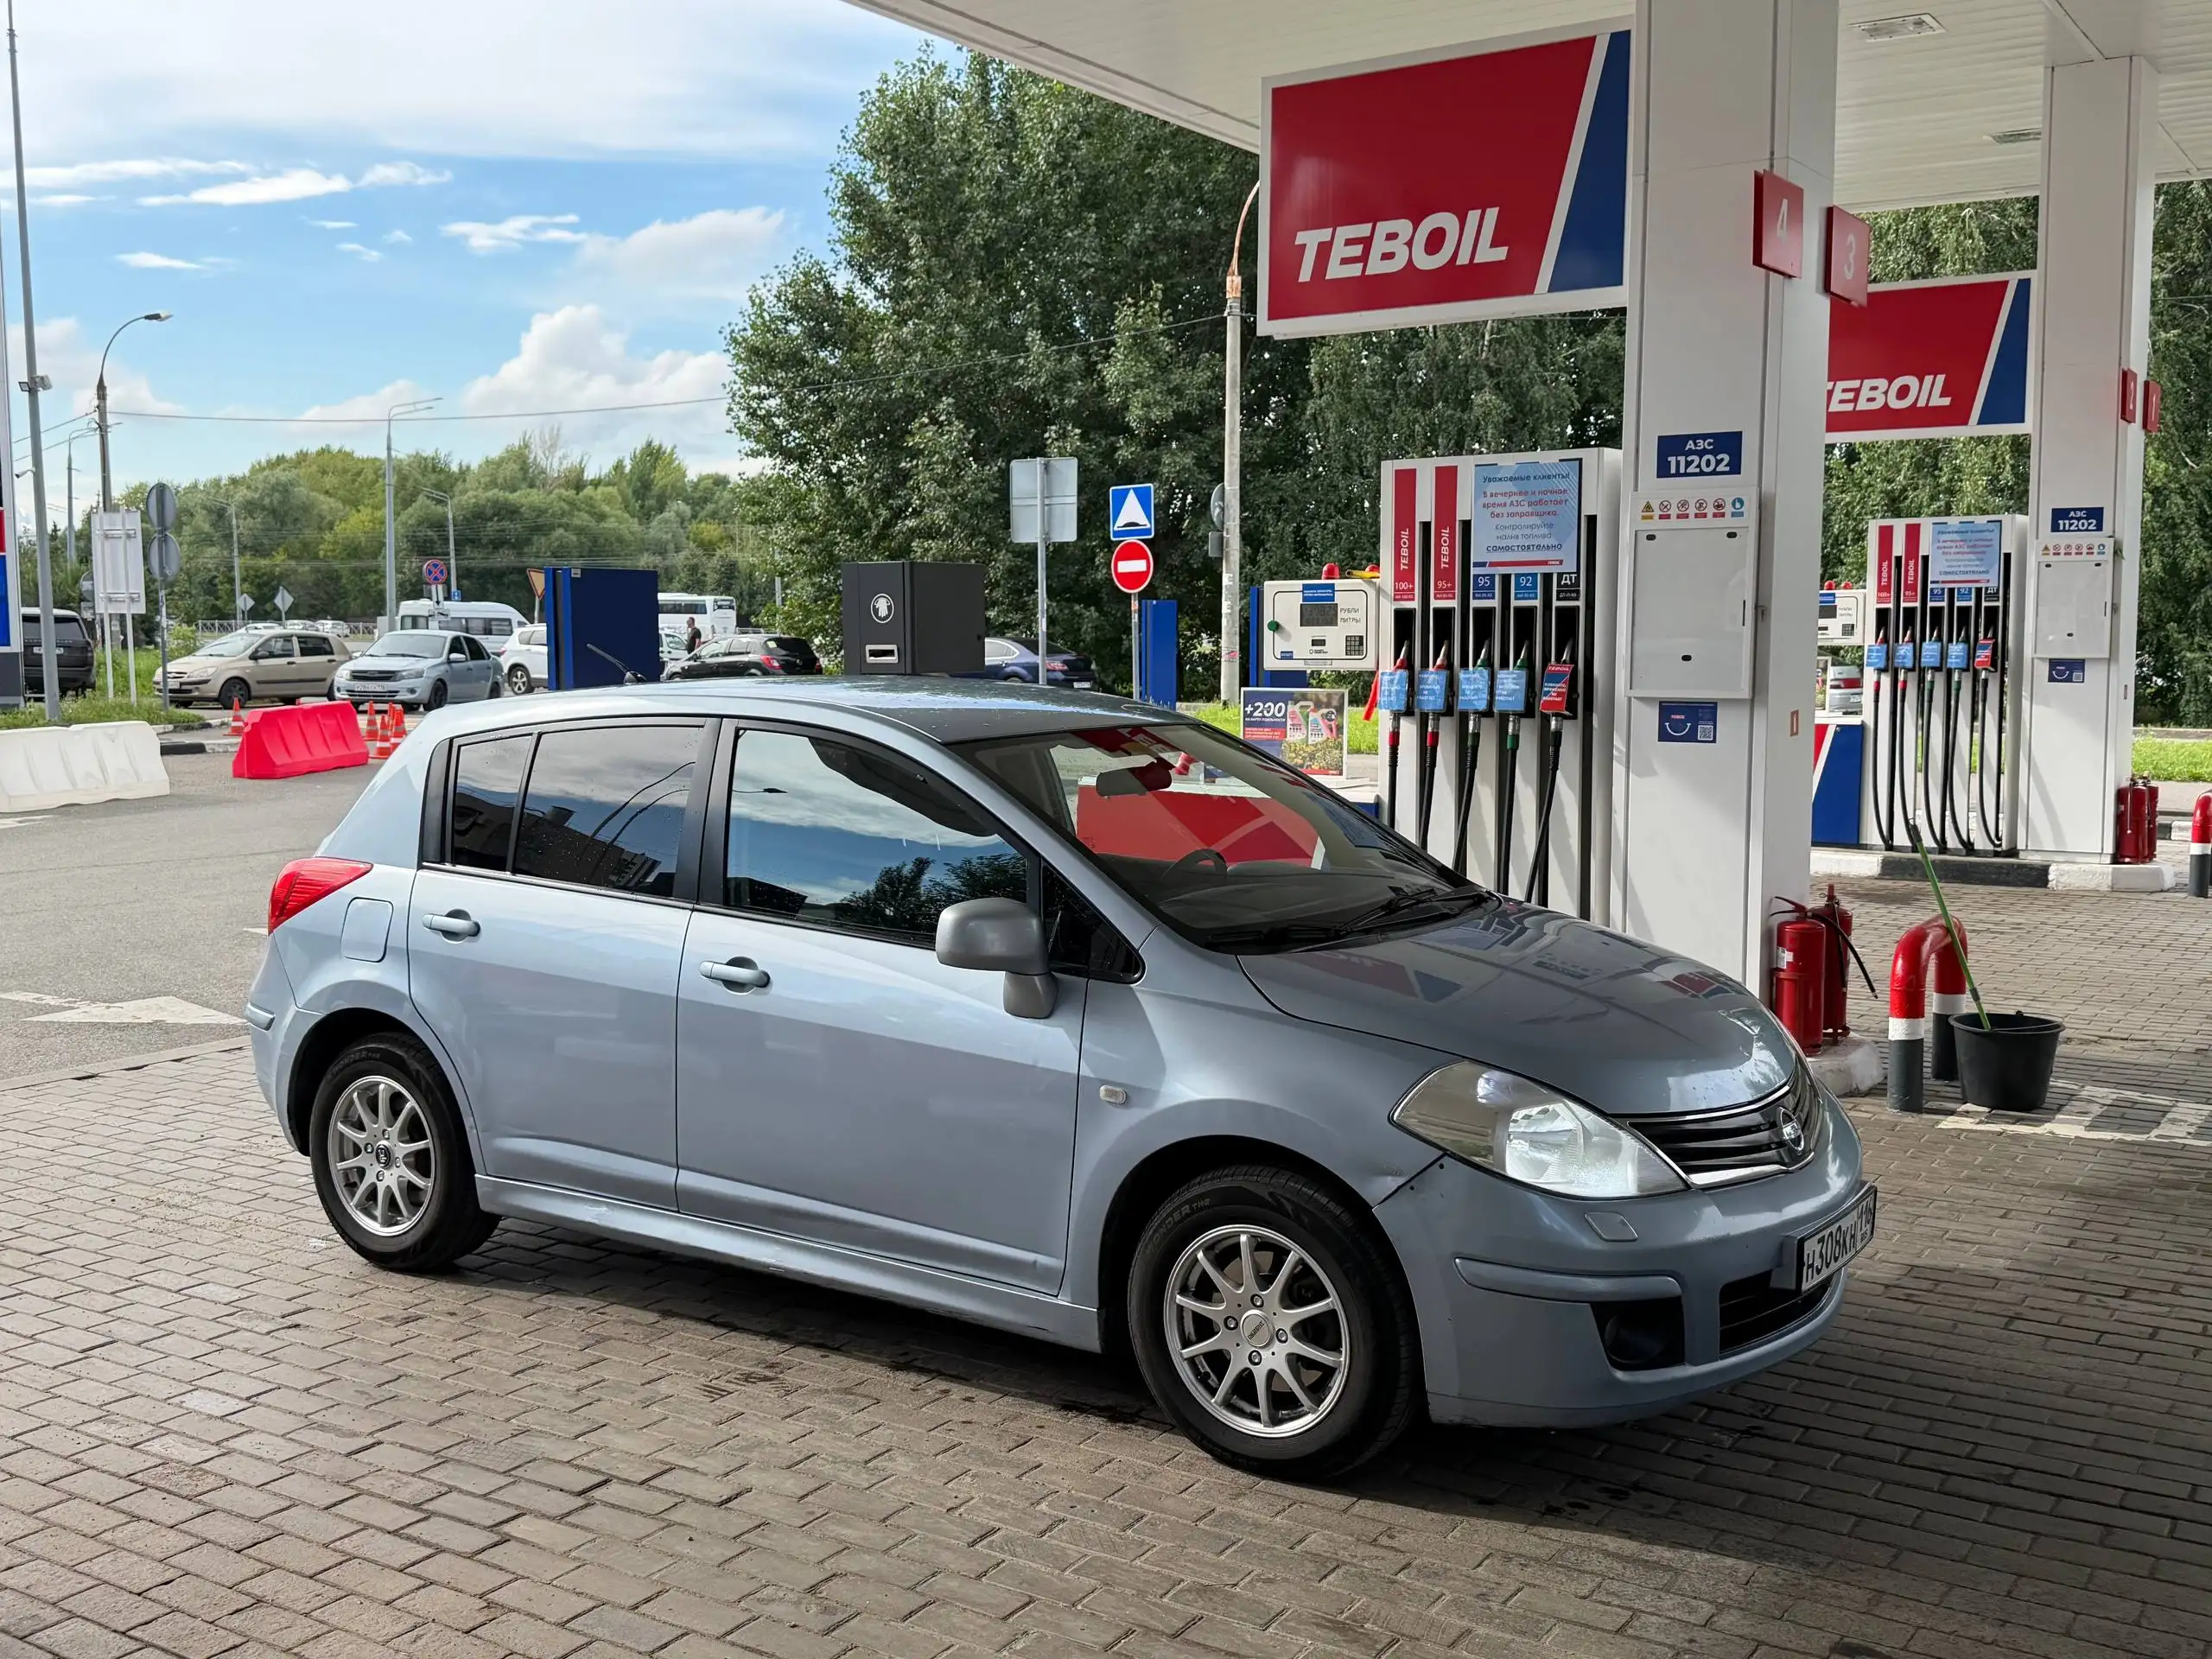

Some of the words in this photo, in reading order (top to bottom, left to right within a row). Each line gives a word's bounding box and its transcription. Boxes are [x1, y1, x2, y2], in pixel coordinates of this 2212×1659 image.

[1777, 198, 1789, 243] 4
[1294, 207, 1509, 283] TEBOIL
[1844, 233, 1856, 280] 3
[2129, 381, 2134, 410] 2
[1685, 439, 1714, 450] АЗС
[1668, 454, 1730, 474] 11202
[1490, 490, 1529, 499] вечернее
[1483, 501, 1507, 510] время
[1528, 499, 1568, 508] работает
[1495, 521, 1554, 531] Контролируйте
[2058, 519, 2097, 531] 11202
[1401, 528, 1409, 570] TEBOIL
[1440, 526, 1449, 569] TEBOIL
[1486, 543, 1563, 552] самостоятельно
[1395, 582, 1414, 590] 100+
[1478, 576, 1491, 587] 95
[1520, 576, 1532, 587] 92
[1561, 574, 1577, 586] ДТ
[1245, 702, 1286, 717] +200
[1805, 1220, 1857, 1283] Н308КН
[1858, 1195, 1873, 1232] 116
